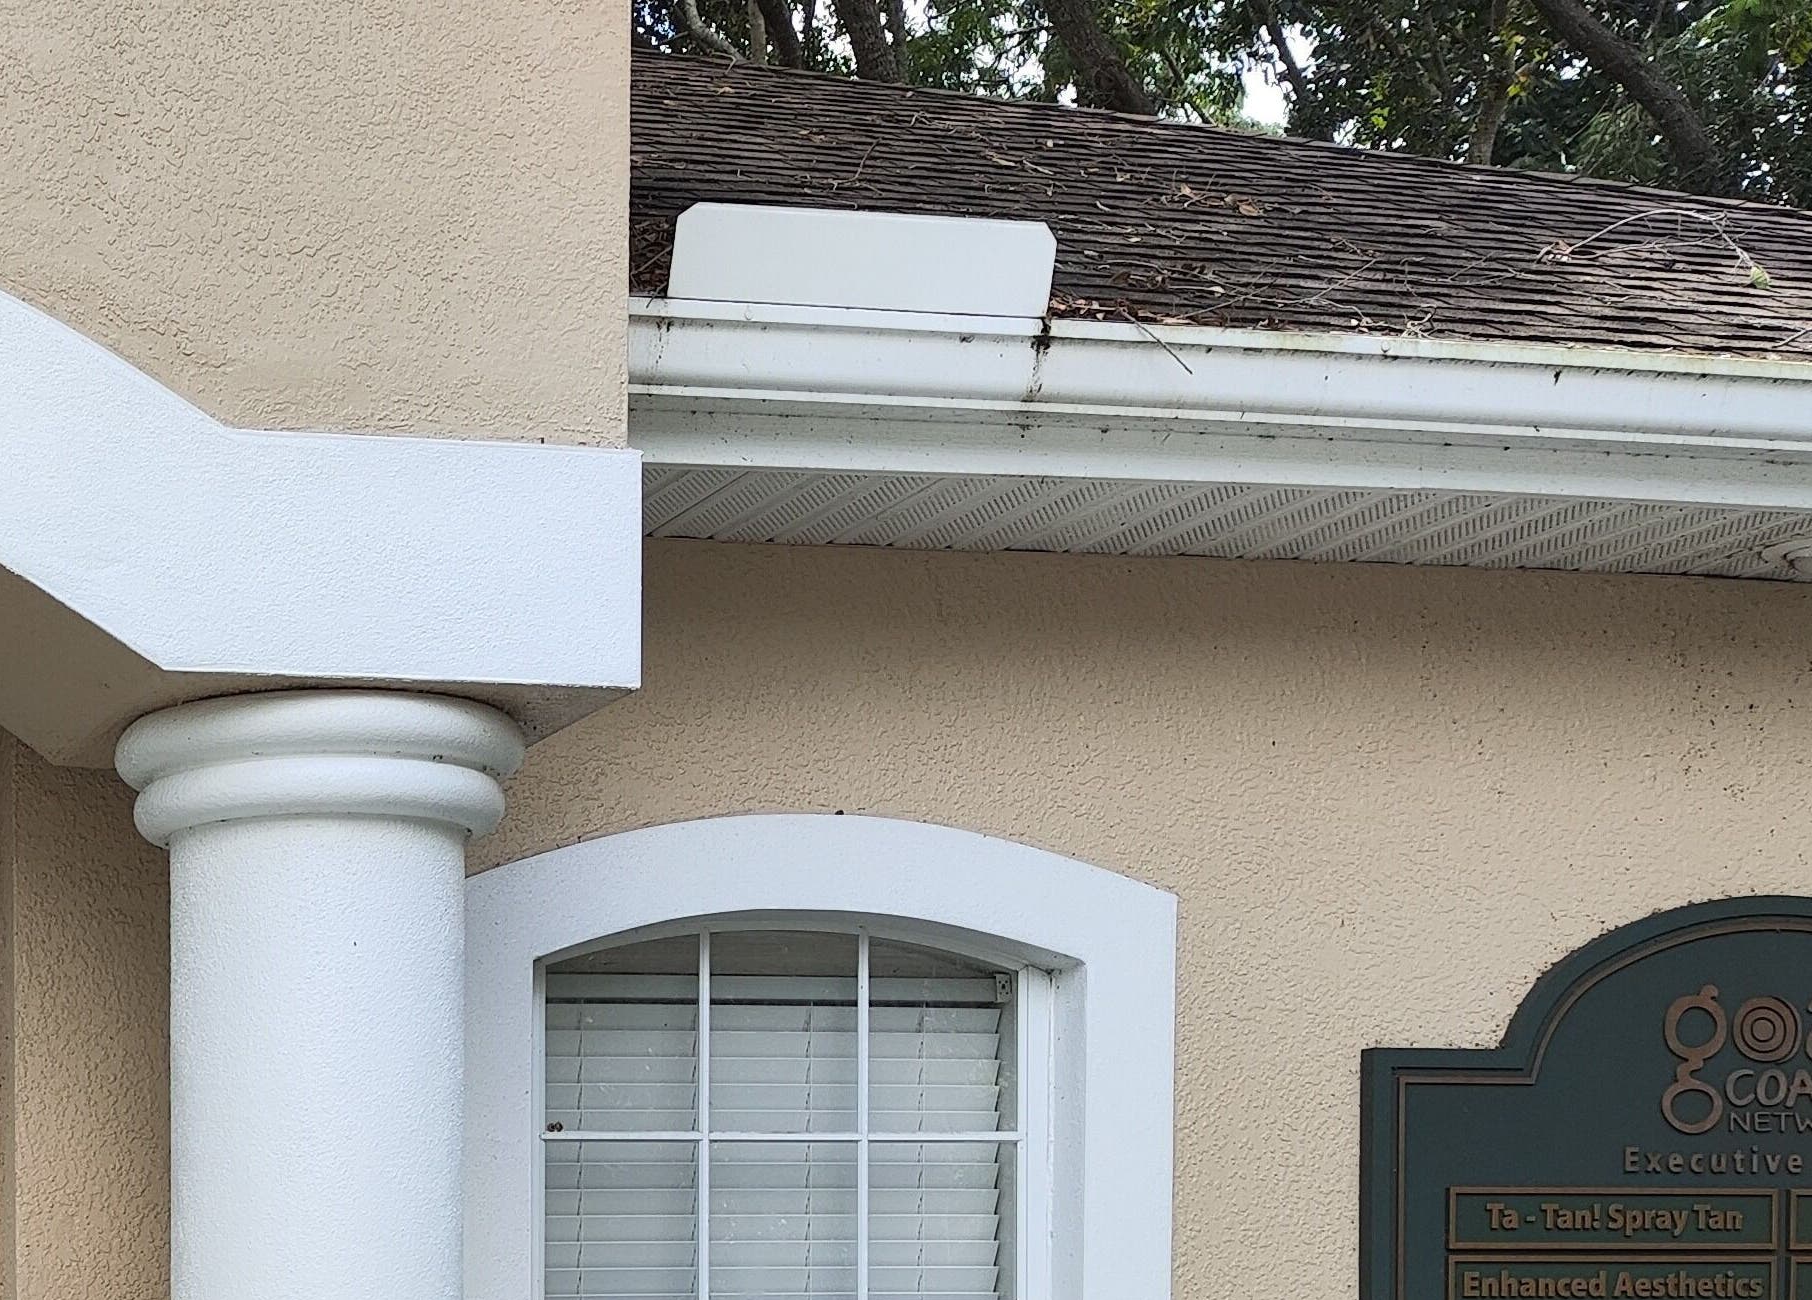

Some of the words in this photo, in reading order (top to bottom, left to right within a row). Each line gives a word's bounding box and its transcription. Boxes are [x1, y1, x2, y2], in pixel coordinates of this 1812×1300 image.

[1625, 1146, 1803, 1174] Executive
[1541, 1203, 1602, 1231] Tan!
[1607, 1203, 1688, 1237] Spray
[1693, 1204, 1743, 1231] Tan
[1462, 1270, 1606, 1299] Enhanced
[1613, 1270, 1764, 1299] Aesthetics
